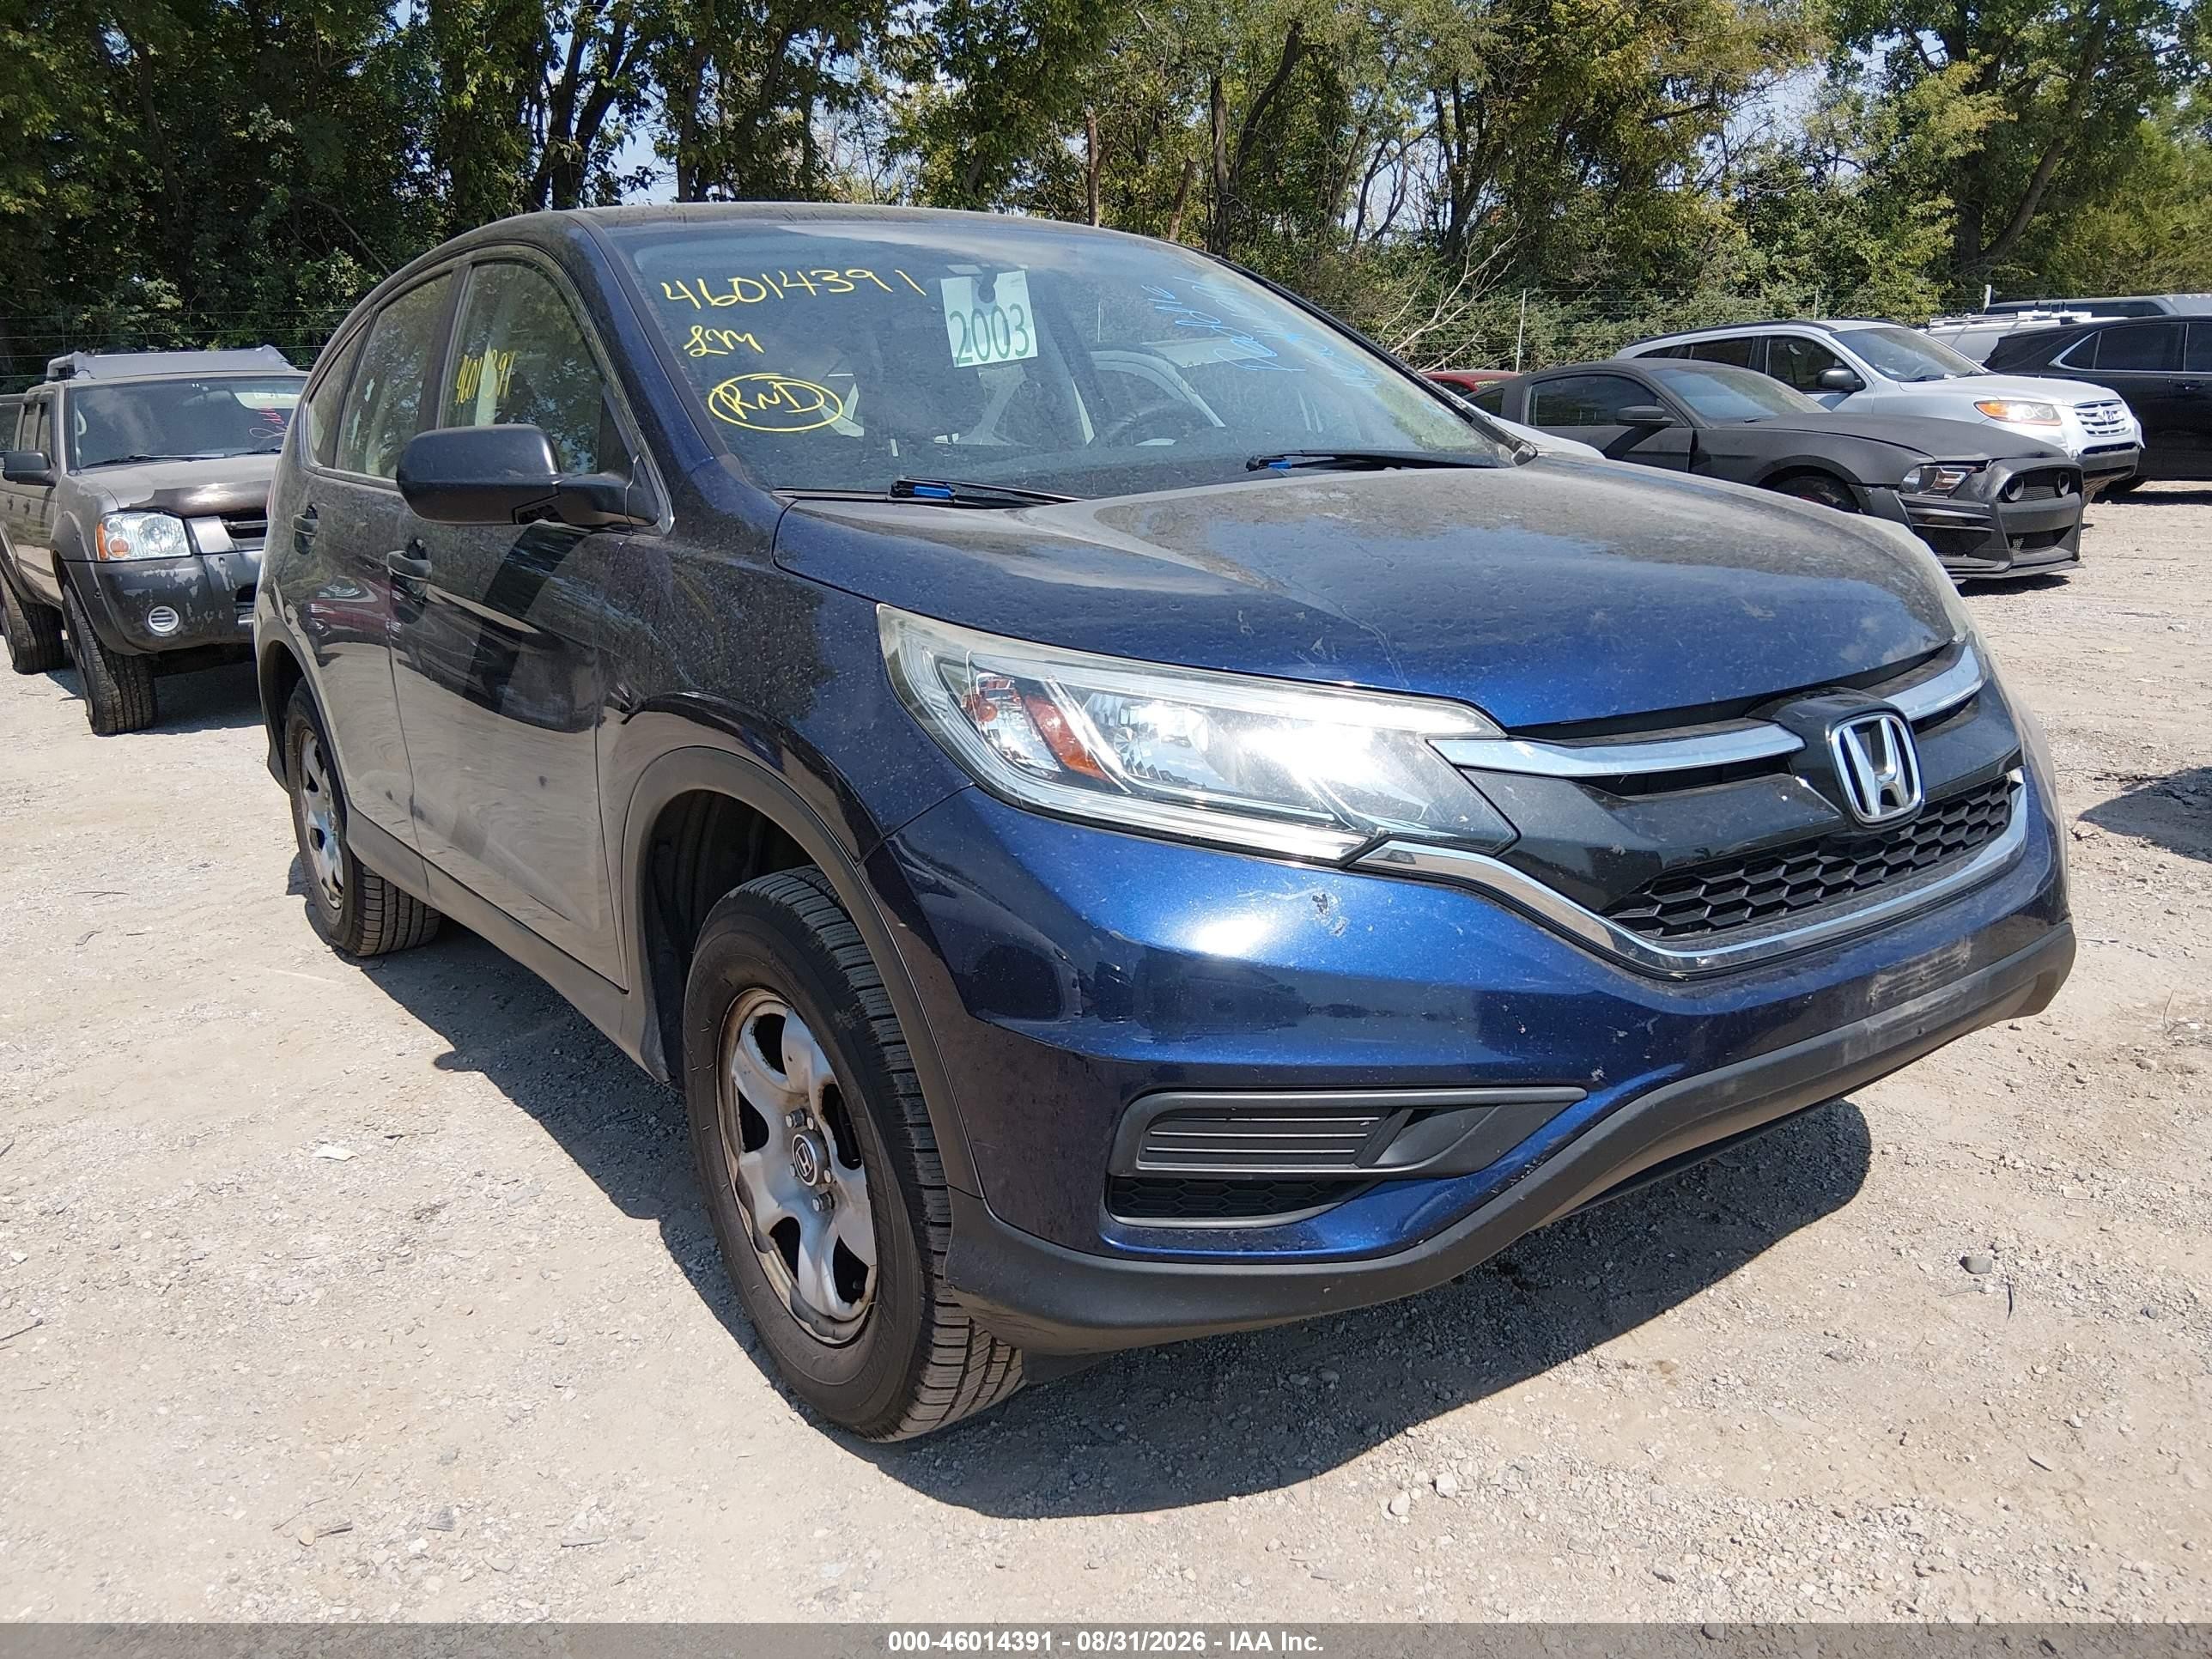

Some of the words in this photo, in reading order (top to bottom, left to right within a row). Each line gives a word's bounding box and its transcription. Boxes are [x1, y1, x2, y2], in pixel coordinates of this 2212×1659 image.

[659, 268, 927, 310] 46014391
[949, 302, 1030, 364] 2003
[719, 380, 825, 420] RND
